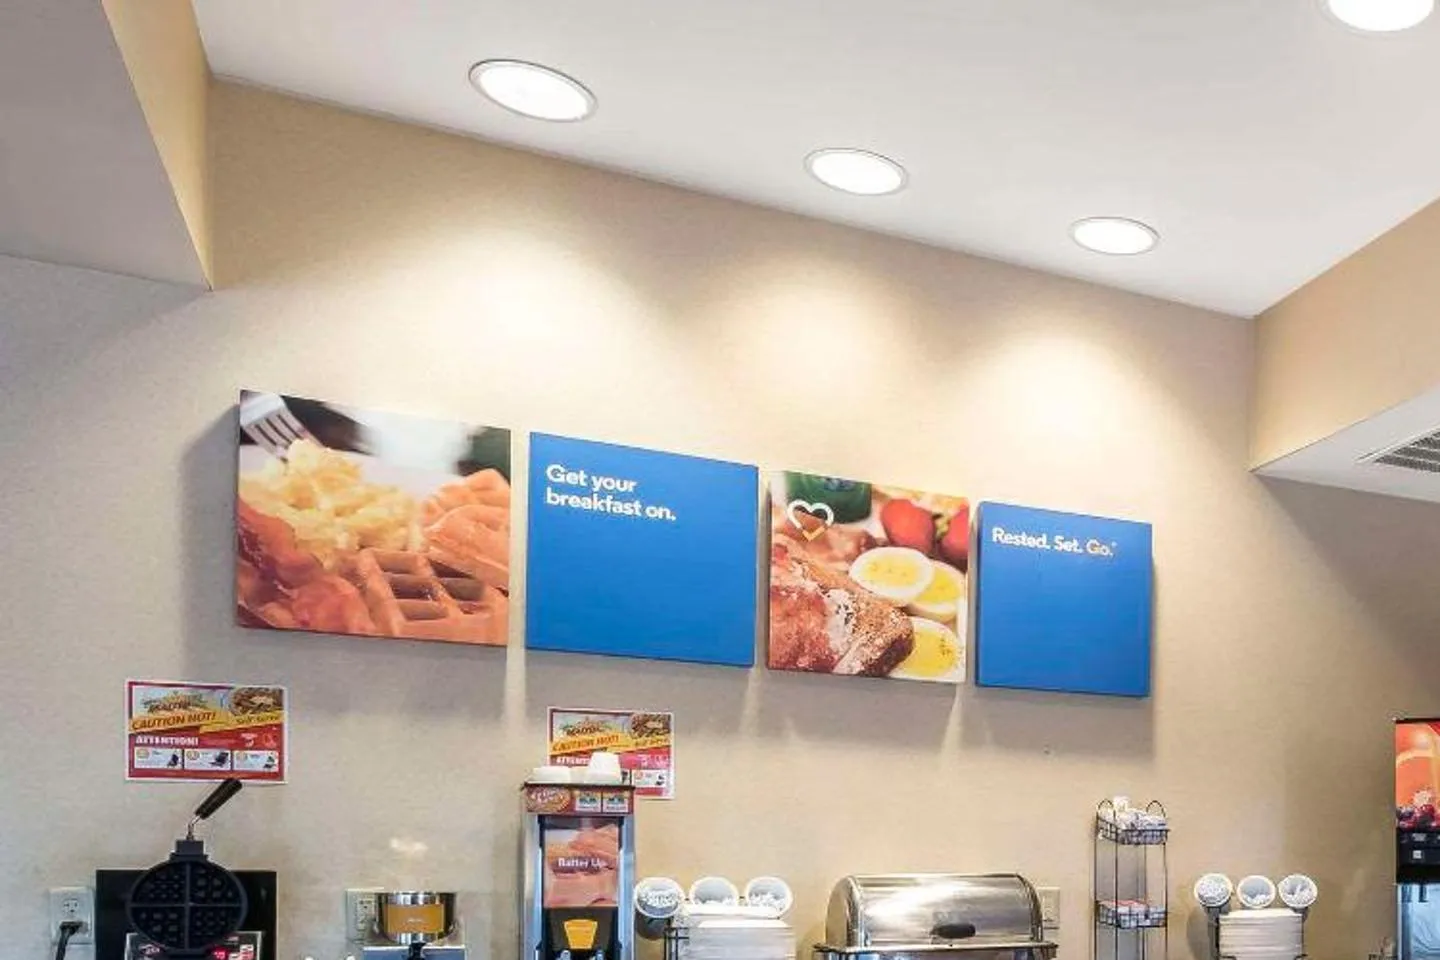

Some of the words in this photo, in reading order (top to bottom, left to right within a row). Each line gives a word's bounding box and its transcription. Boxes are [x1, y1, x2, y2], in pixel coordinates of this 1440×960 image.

[546, 464, 588, 486] Get
[591, 475, 638, 492] your
[546, 487, 642, 516] breakfast
[645, 505, 677, 521] on.
[992, 527, 1051, 549] Rested.
[1054, 535, 1083, 553] Set.
[131, 715, 186, 730] CAUTION
